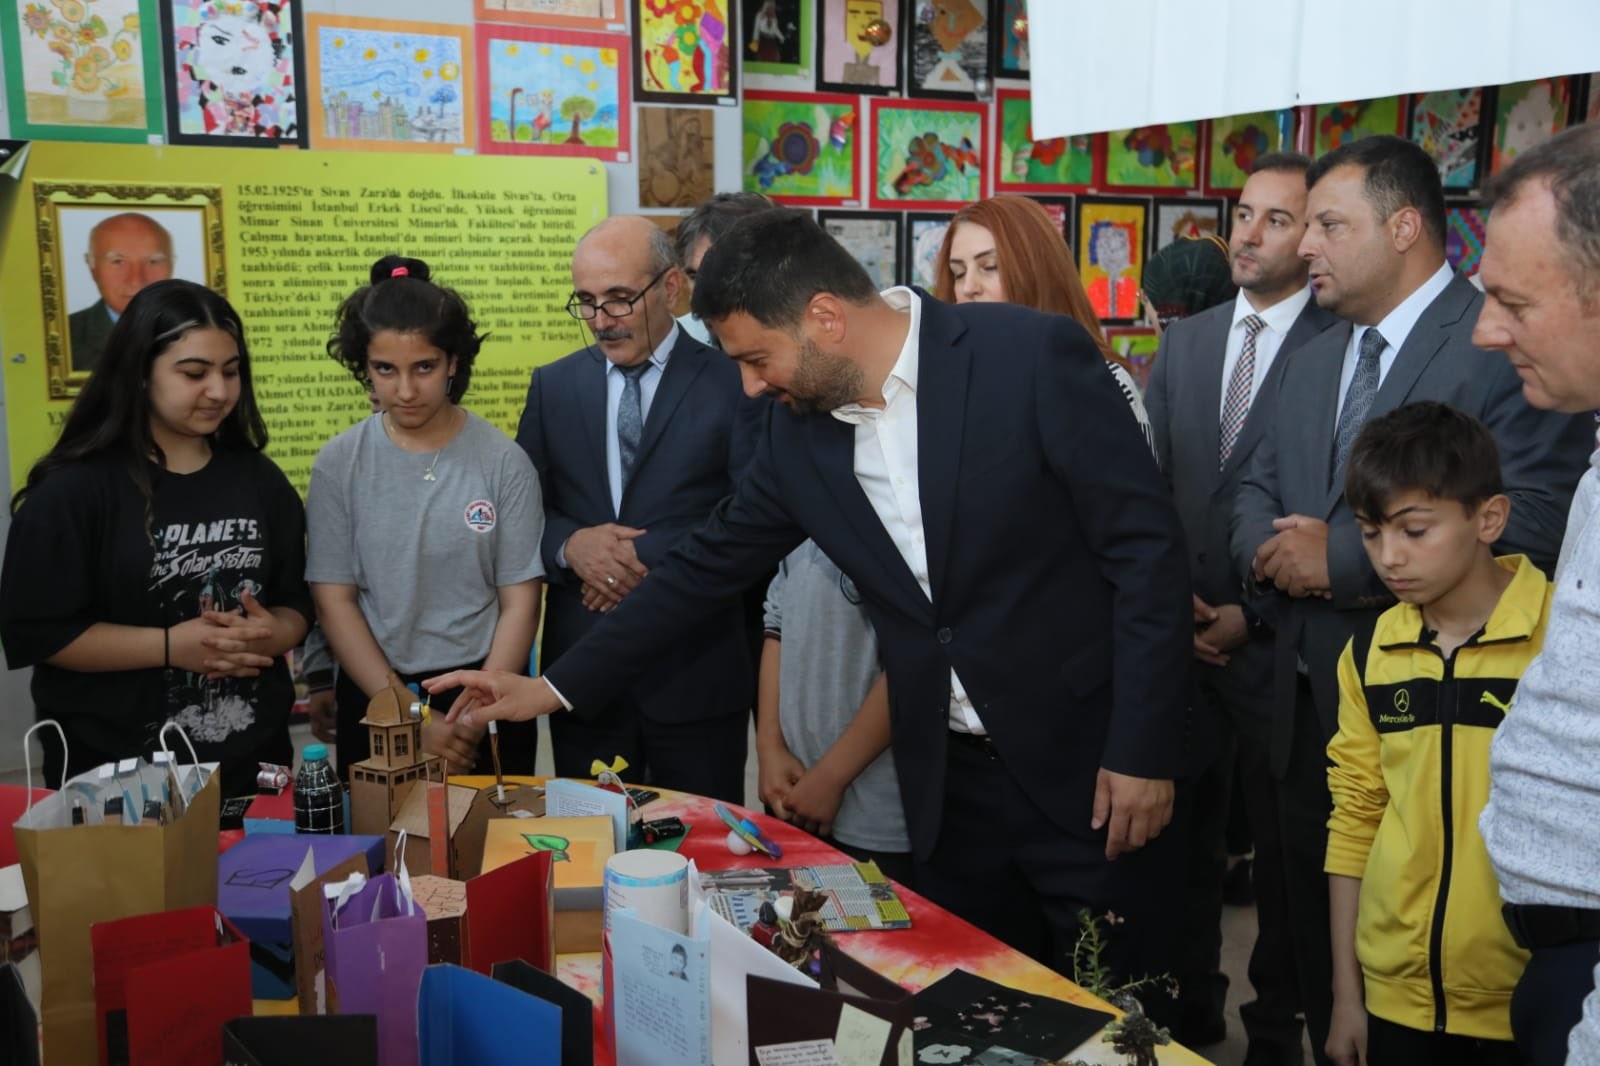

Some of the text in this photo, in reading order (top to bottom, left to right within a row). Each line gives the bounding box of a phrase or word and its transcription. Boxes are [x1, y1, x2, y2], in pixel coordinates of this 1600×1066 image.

[321, 187, 350, 197] Sivas
[360, 187, 401, 198] Zara'da
[552, 192, 576, 200] Orta
[238, 200, 302, 212] öğrenimini
[312, 199, 358, 212] İstanbul
[368, 202, 402, 212] Erkek
[476, 204, 514, 214] Yüksek
[524, 206, 576, 216] öğrenimini
[240, 216, 280, 226] Mimar
[290, 216, 323, 226] Sinan
[334, 214, 398, 227] Üniversitesi
[408, 218, 458, 228] Mimarlık
[240, 230, 288, 244] Çalışma
[355, 230, 416, 242] İstanbul'da
[424, 234, 462, 243] mimari
[242, 247, 268, 256] 1953
[272, 246, 311, 259] yılında
[316, 246, 360, 256] askerlik
[306, 262, 333, 273] çelik
[242, 279, 275, 287] sonra
[283, 278, 348, 288] alüminyum
[512, 290, 558, 300] üretimini
[282, 336, 322, 348] yılında
[253, 374, 274, 382] 987
[277, 373, 316, 386] yılında
[257, 390, 294, 399] Ahmet
[296, 386, 366, 400] ÇUHADAR
[294, 402, 322, 412] Sivas
[266, 418, 315, 431] tüphane
[162, 518, 258, 548] PLANETS
